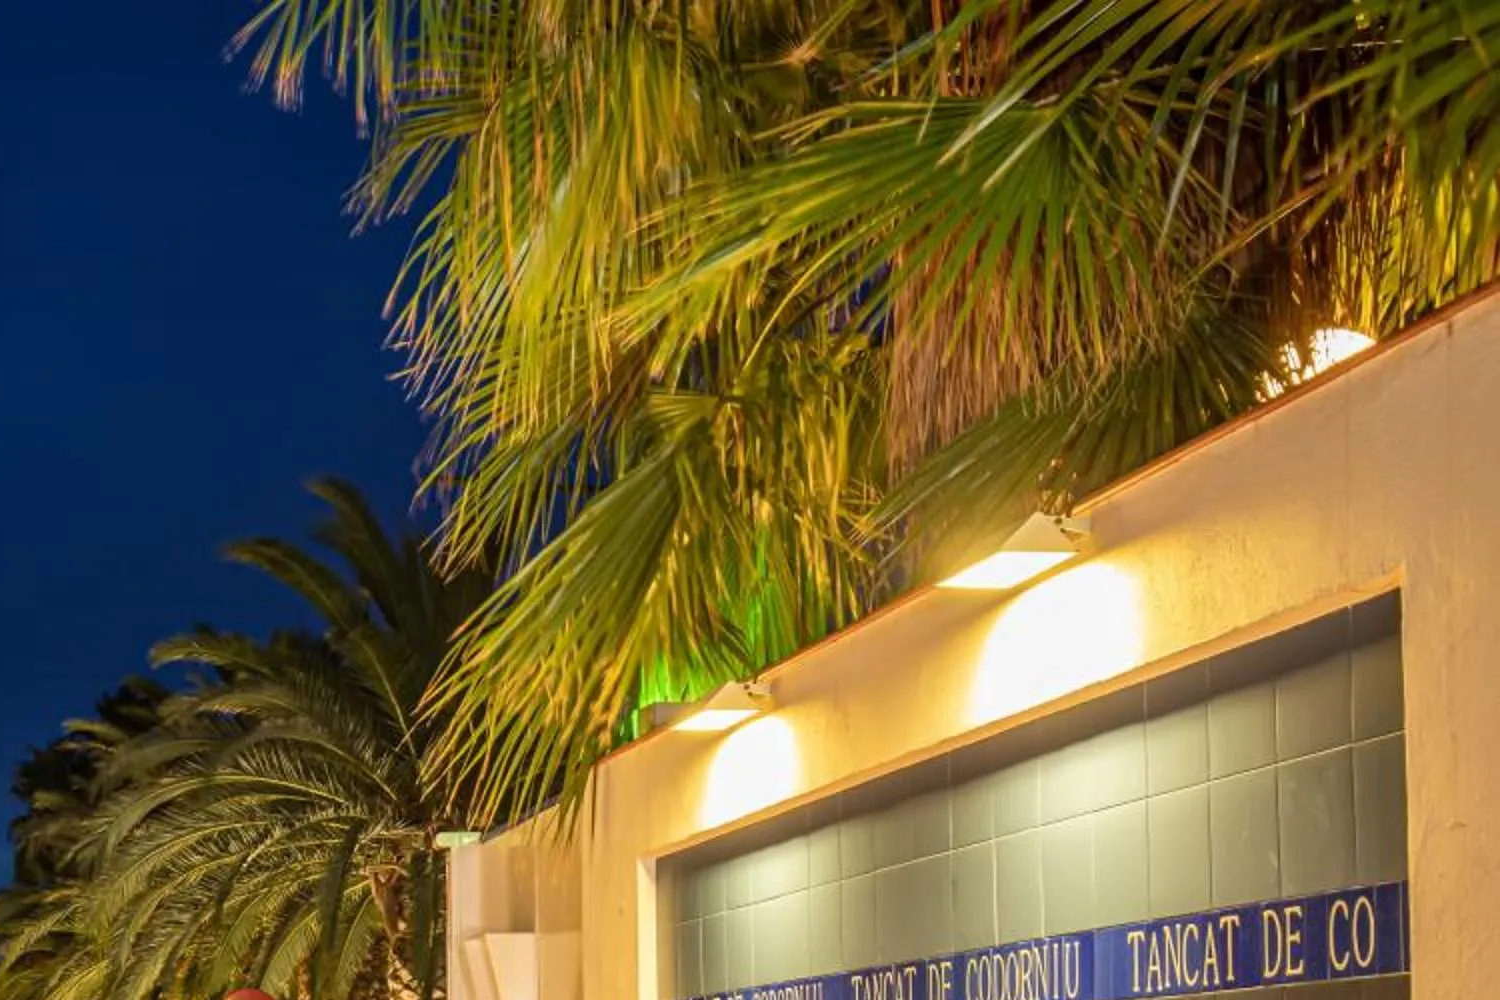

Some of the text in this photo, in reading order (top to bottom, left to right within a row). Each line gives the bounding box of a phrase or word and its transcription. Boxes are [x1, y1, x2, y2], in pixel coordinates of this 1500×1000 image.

[1127, 914, 1240, 993] TANCAT
[1263, 905, 1304, 978] DE
[1328, 896, 1375, 971] CO
